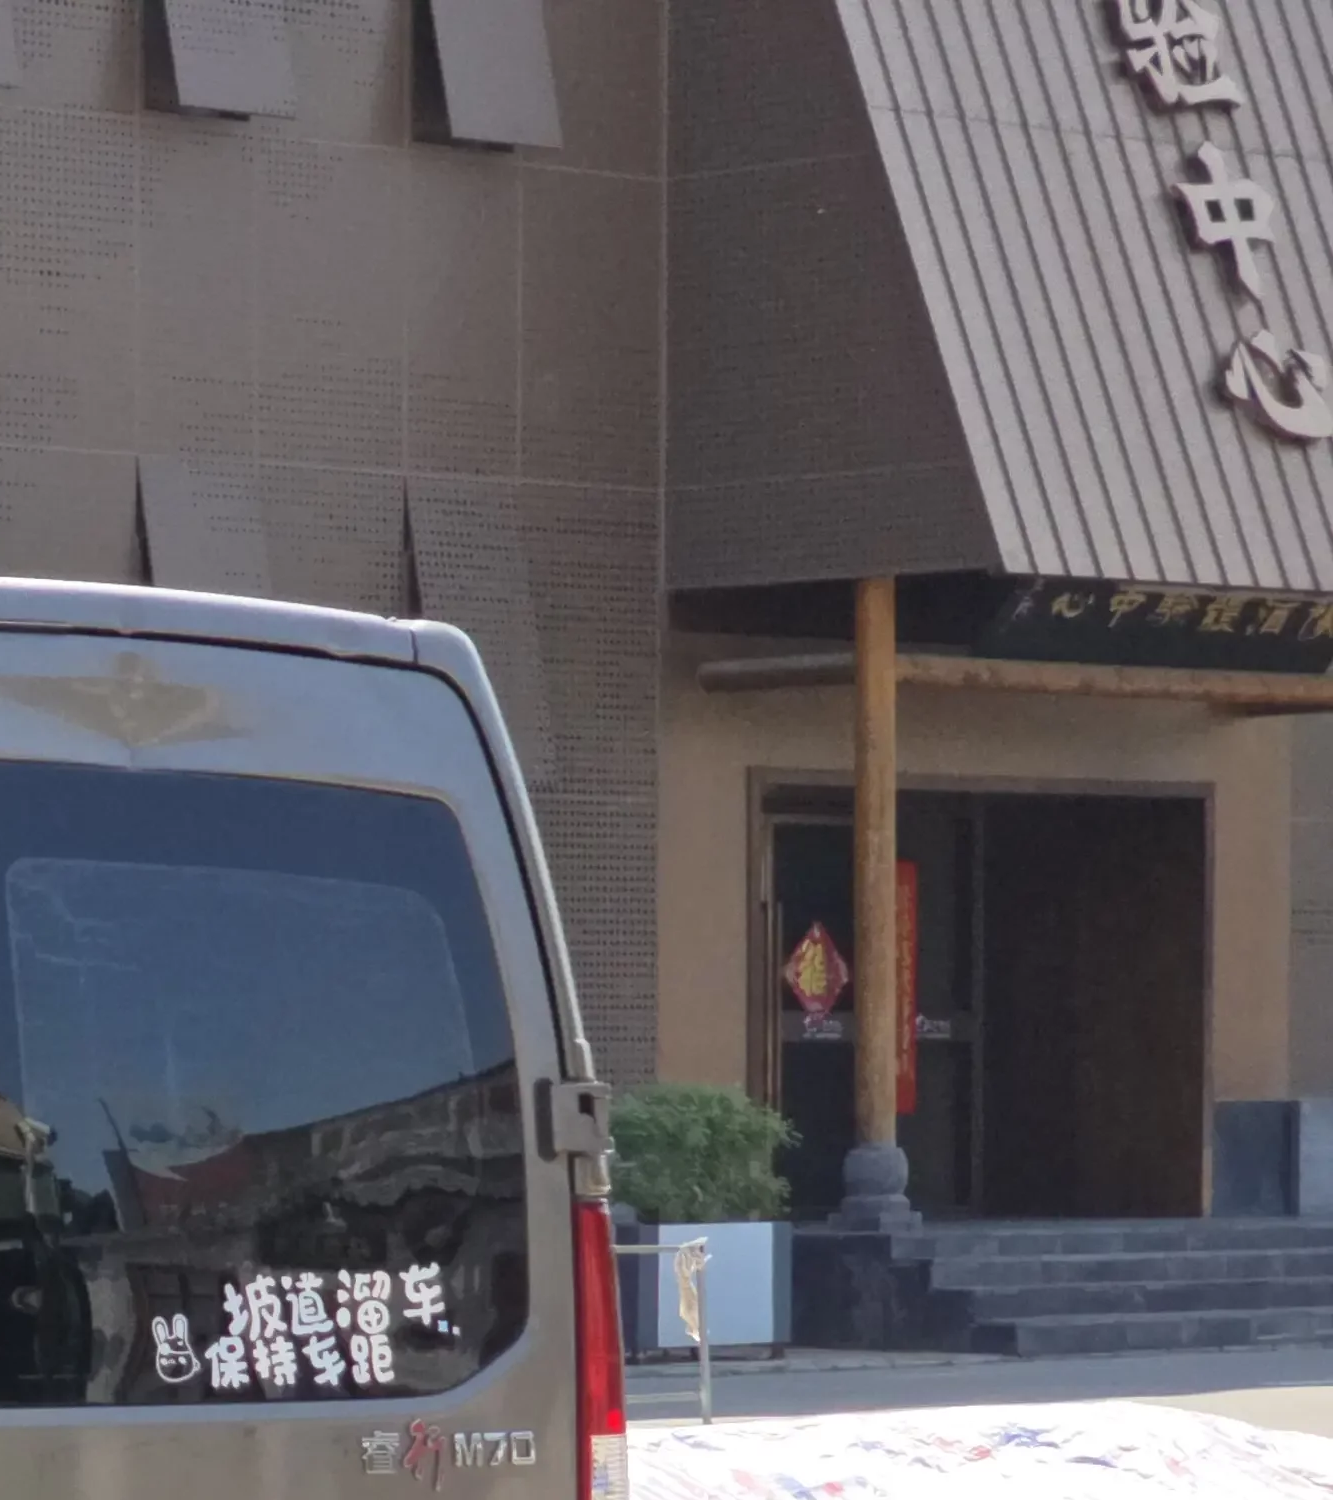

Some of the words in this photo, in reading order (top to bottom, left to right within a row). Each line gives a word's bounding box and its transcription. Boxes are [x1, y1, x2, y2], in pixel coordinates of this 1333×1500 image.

[205, 1335, 394, 1388] 保持车距
[453, 1430, 536, 1467] M70
